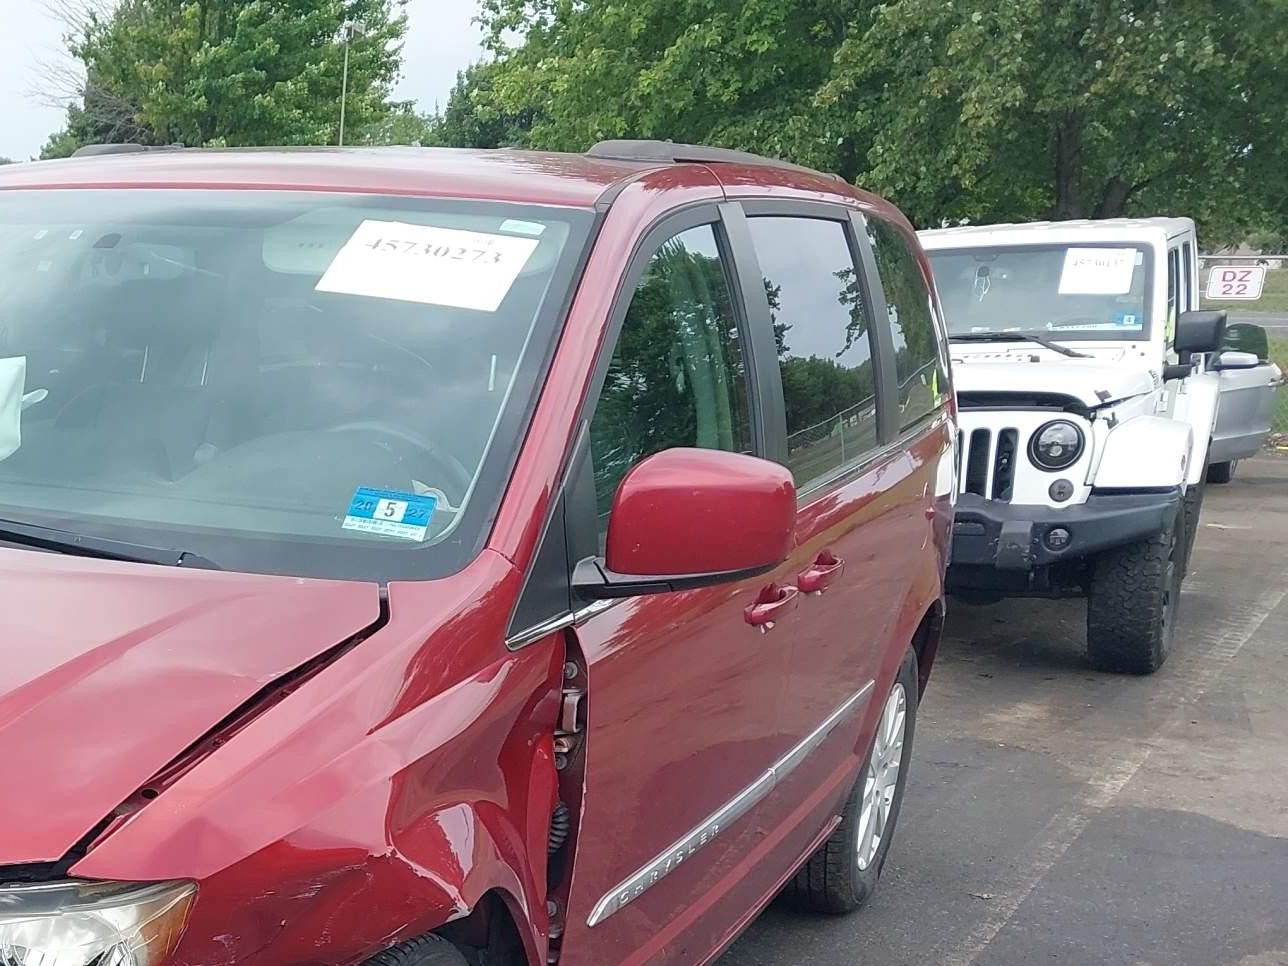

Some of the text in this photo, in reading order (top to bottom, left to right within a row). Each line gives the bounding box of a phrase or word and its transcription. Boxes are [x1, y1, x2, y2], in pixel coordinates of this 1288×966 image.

[365, 238, 503, 264] 45730273
[1221, 270, 1252, 282] DZ
[1222, 283, 1247, 295] 22
[383, 501, 396, 518] 5
